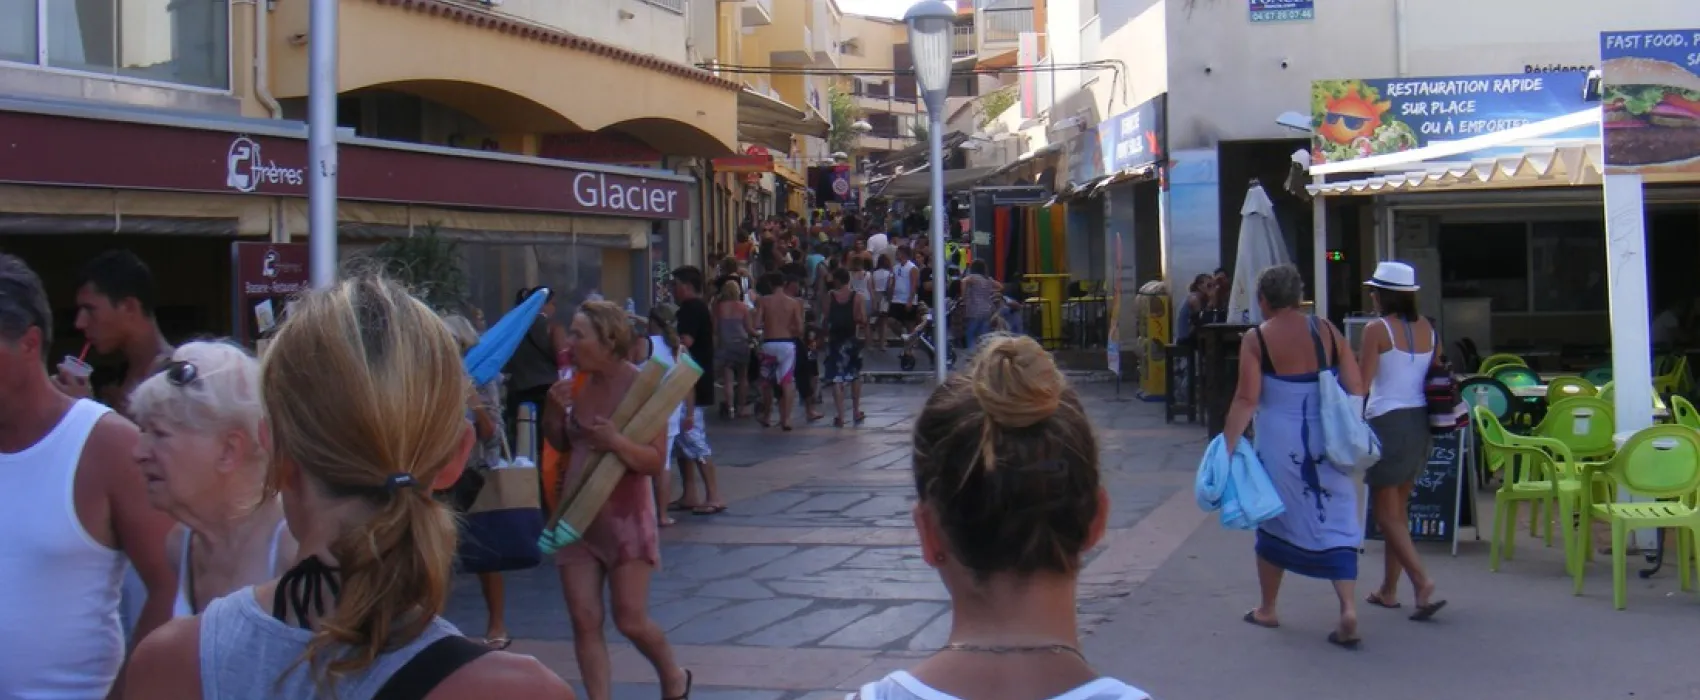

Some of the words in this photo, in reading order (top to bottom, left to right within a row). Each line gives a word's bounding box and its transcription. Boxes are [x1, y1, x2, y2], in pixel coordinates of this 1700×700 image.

[1606, 35, 1641, 49] FAST
[1644, 33, 1688, 48] FOOD,
[1387, 79, 1488, 97] RESTAURATION
[1493, 77, 1544, 93] RAPIDE
[1401, 101, 1428, 116] SUR
[1431, 100, 1477, 115] PLACE
[1421, 122, 1440, 134] OU
[1444, 117, 1455, 134] À
[227, 146, 250, 188] 2
[573, 172, 678, 213] Glacier
